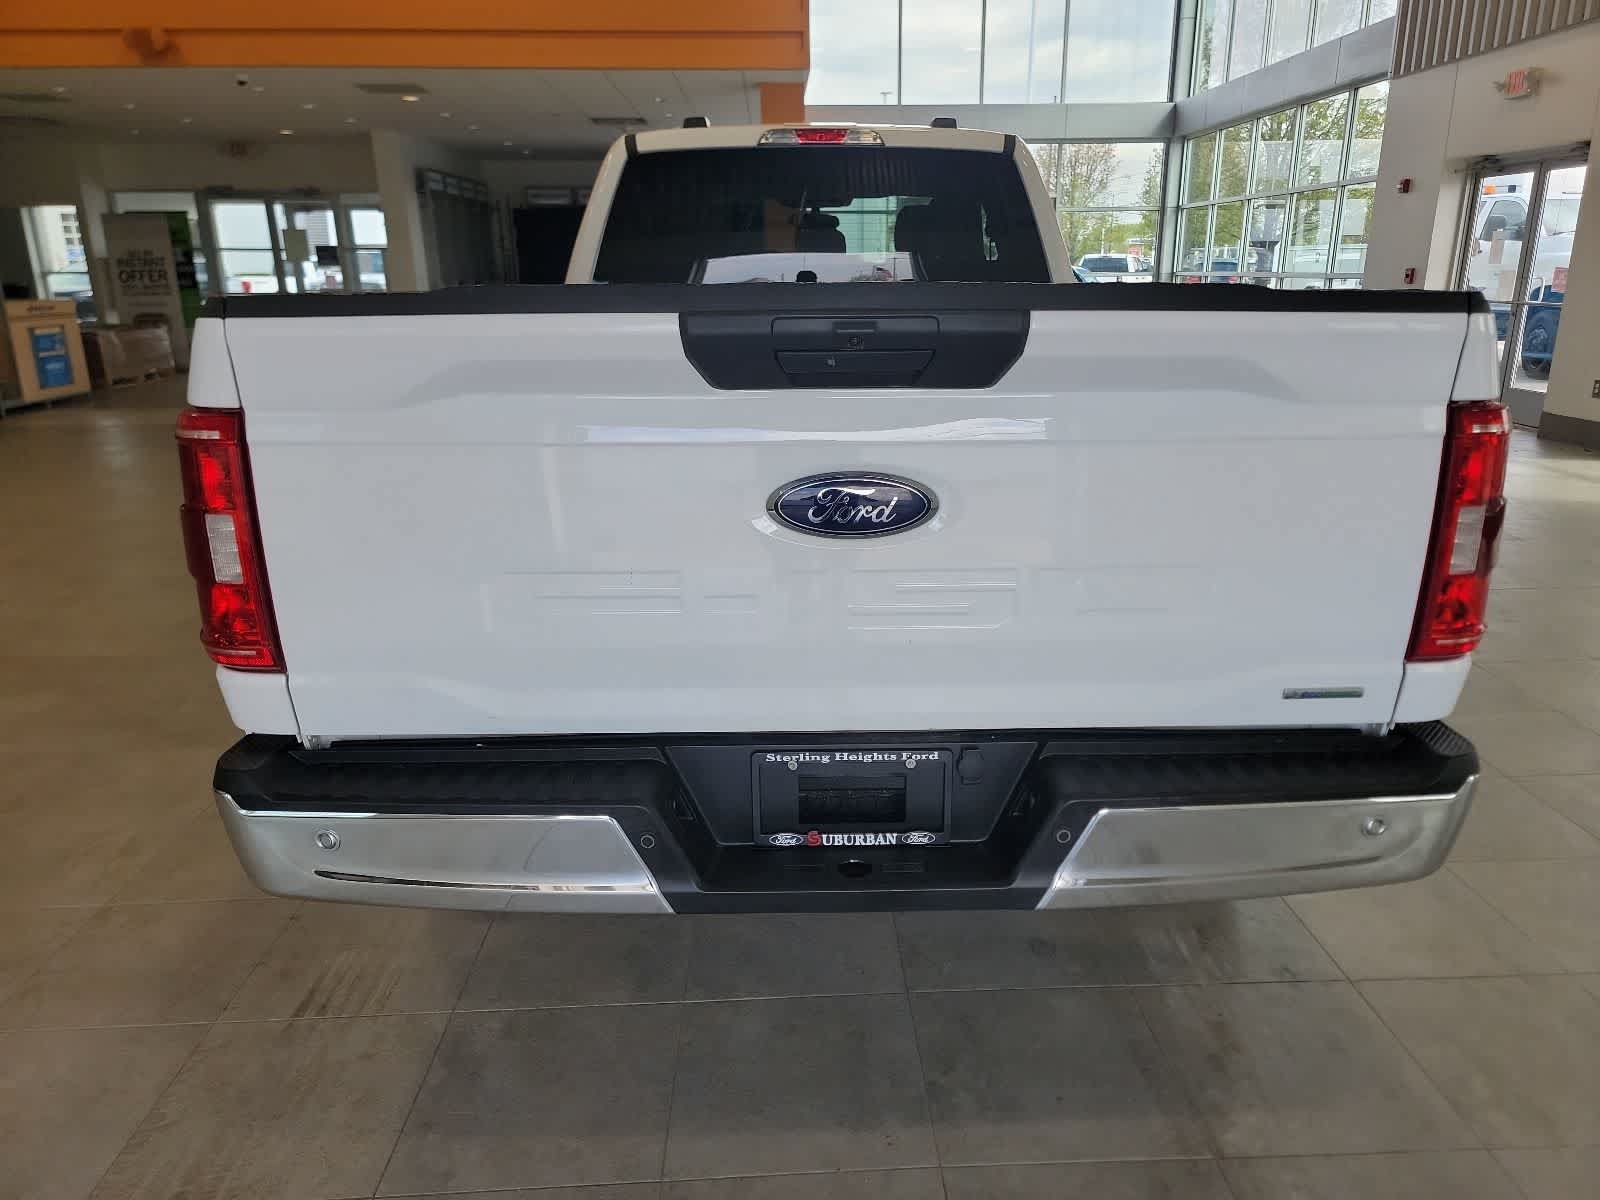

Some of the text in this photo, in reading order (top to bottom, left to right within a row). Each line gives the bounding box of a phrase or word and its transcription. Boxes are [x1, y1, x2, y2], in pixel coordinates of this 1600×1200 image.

[118, 269, 168, 284] OFFER
[808, 487, 897, 524] Ford
[765, 752, 939, 764] Sterling Heights Ford
[807, 831, 898, 847] SUBURBAN
